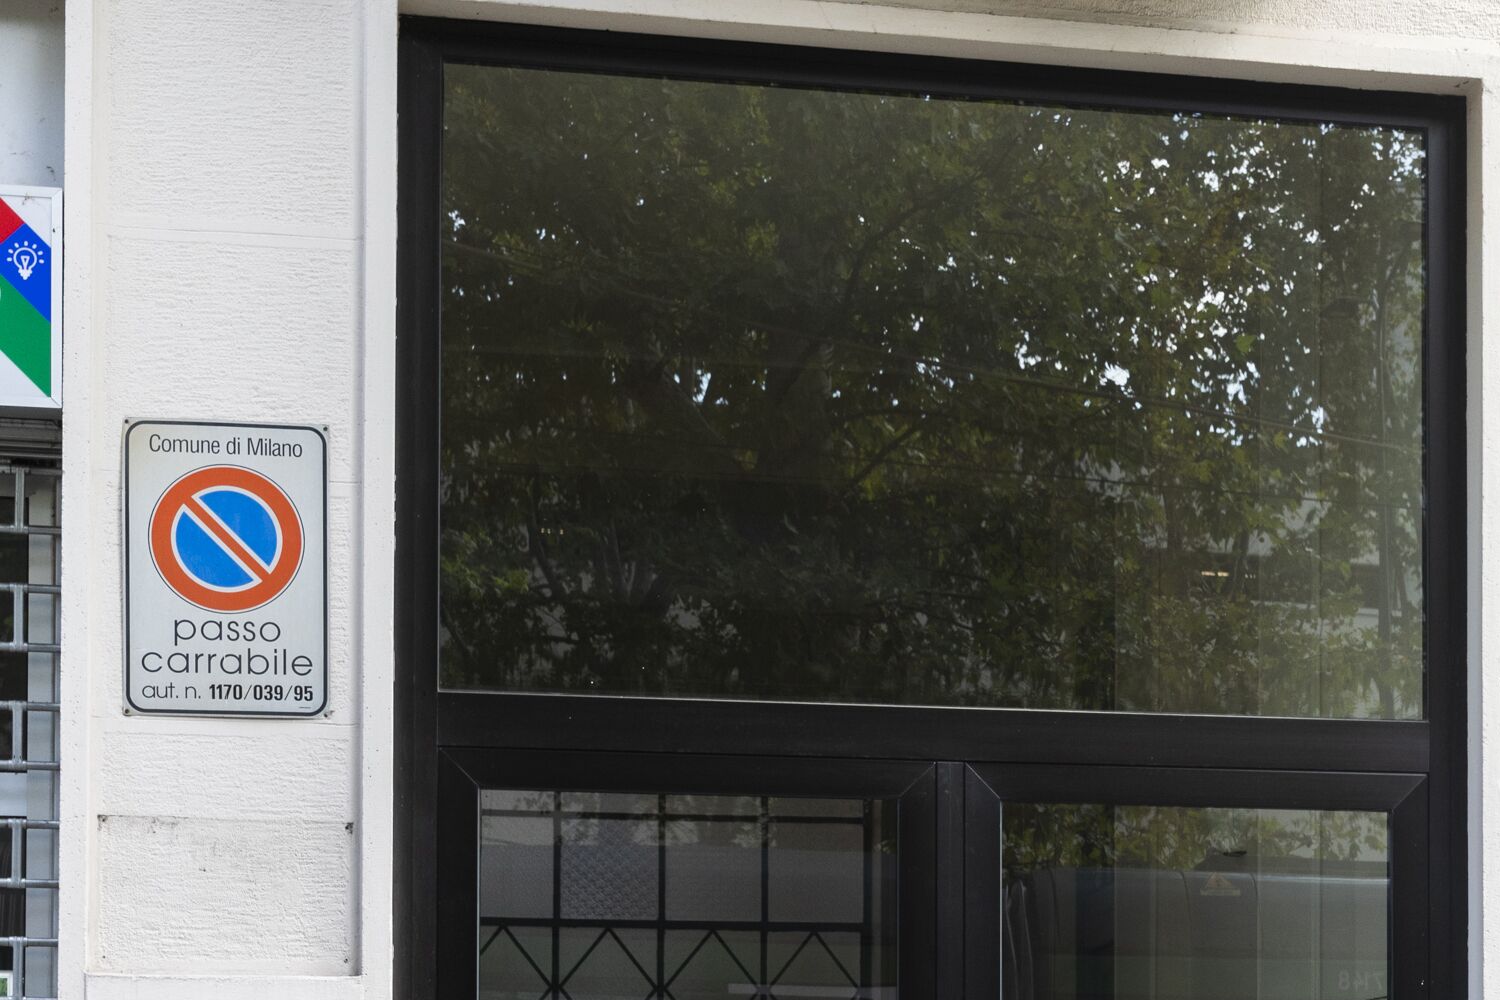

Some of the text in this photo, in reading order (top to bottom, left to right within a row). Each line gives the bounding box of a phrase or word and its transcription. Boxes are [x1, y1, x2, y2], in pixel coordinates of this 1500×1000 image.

[149, 433, 303, 458] Comune di Milano
[174, 619, 281, 646] passo
[141, 648, 313, 676] carrabile
[142, 682, 314, 701] aut. n. 1170/039/95
